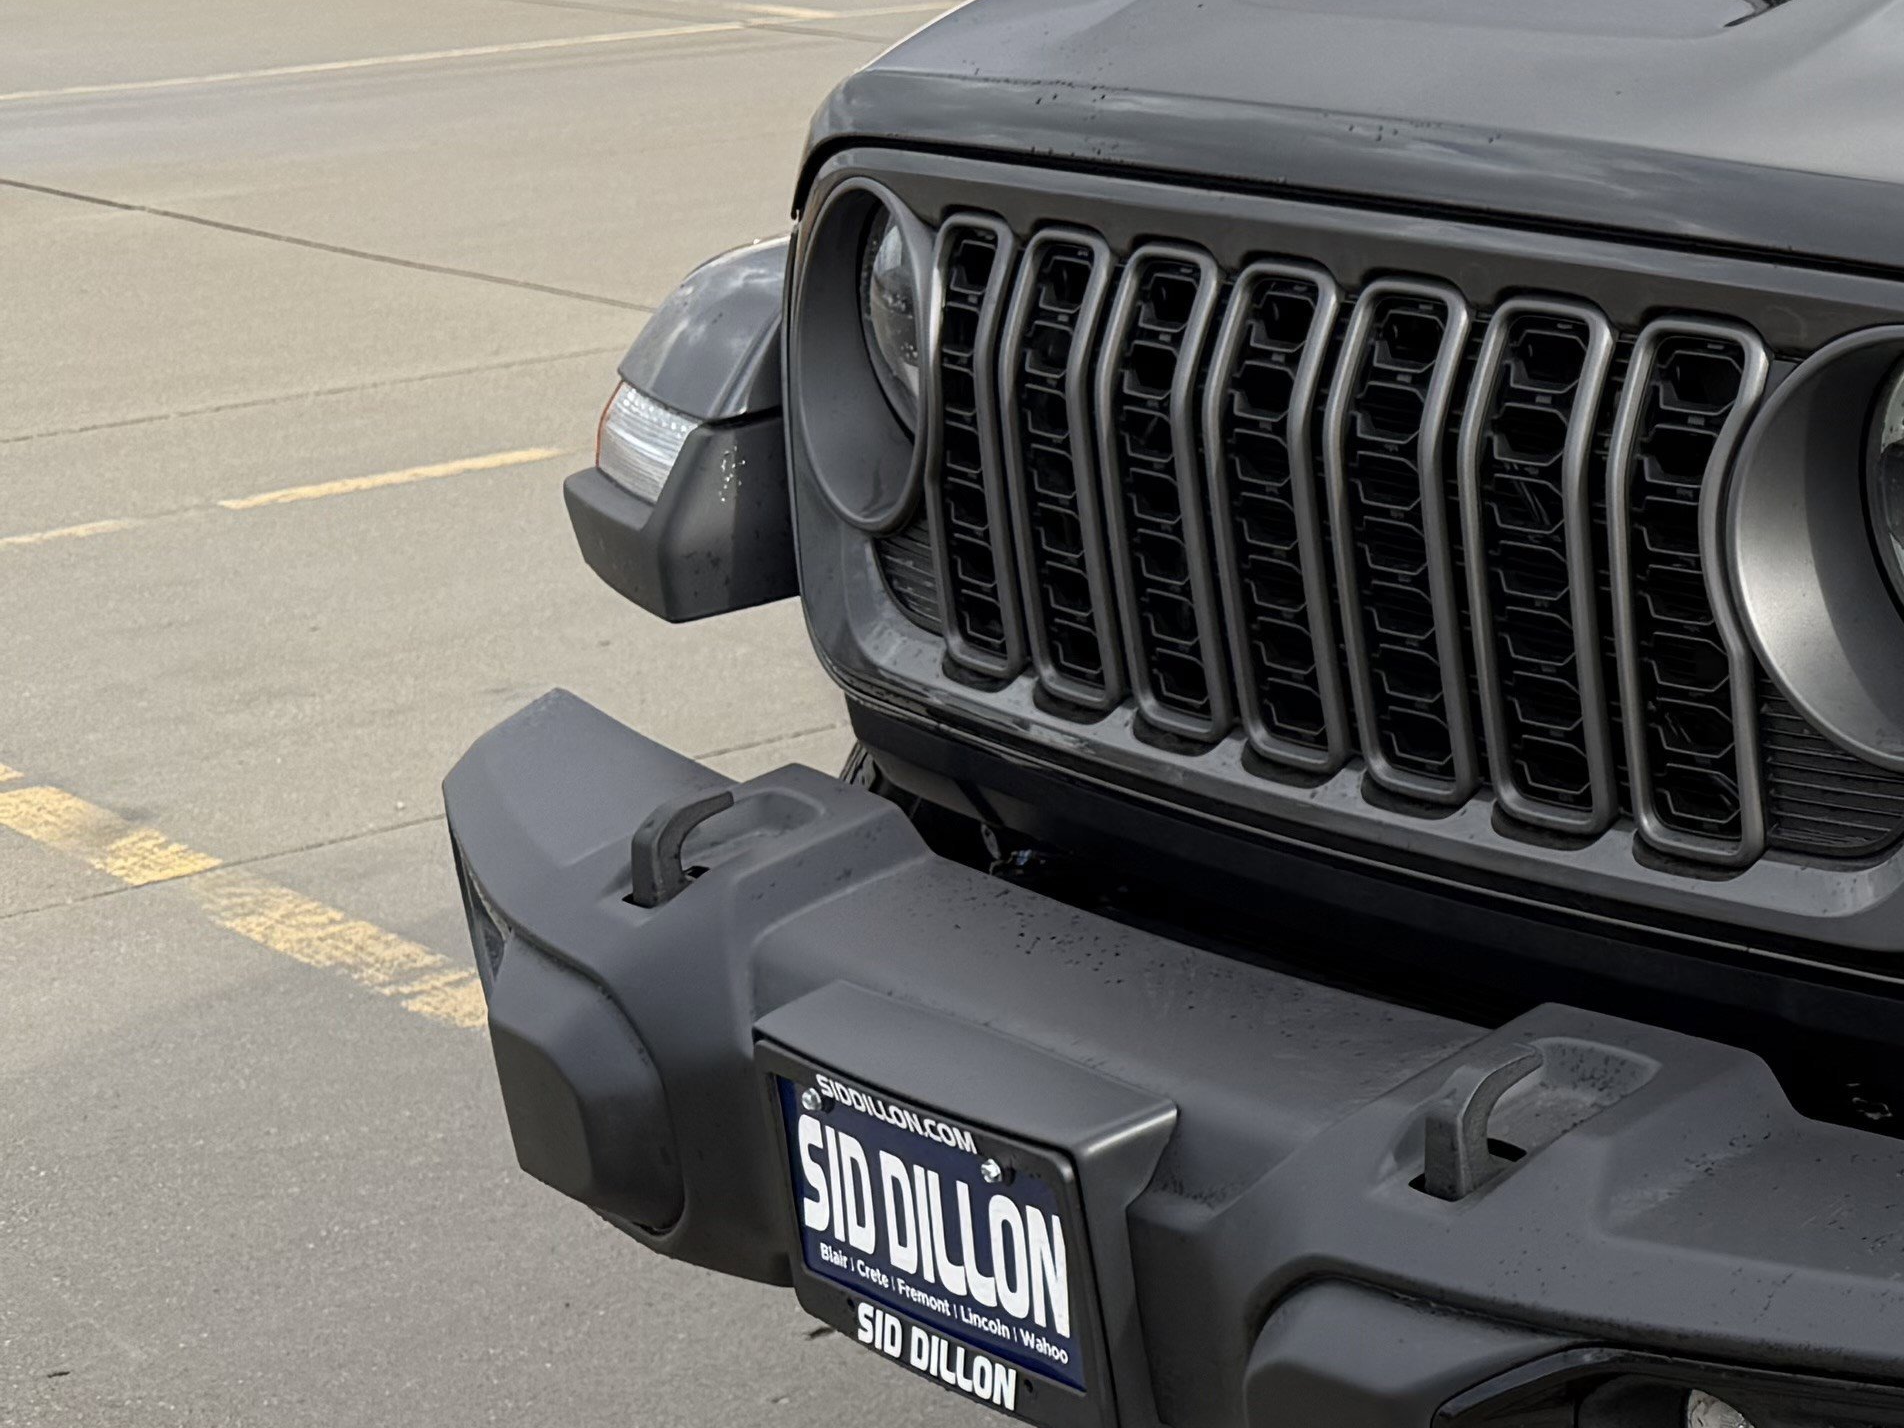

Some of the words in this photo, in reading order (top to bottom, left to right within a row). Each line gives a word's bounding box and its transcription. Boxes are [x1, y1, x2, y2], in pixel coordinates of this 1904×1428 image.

[815, 1073, 979, 1155] SIDDILLON.COM
[798, 1113, 877, 1256] SID
[879, 1149, 1071, 1339] DILLON
[820, 1242, 849, 1270] Blair
[857, 1259, 890, 1291] Crete
[897, 1277, 951, 1316] Fremont
[960, 1304, 1011, 1341] Lincoln
[1019, 1331, 1069, 1366] Wahoo
[857, 1301, 903, 1359] SID
[909, 1326, 1018, 1412] DILLON
